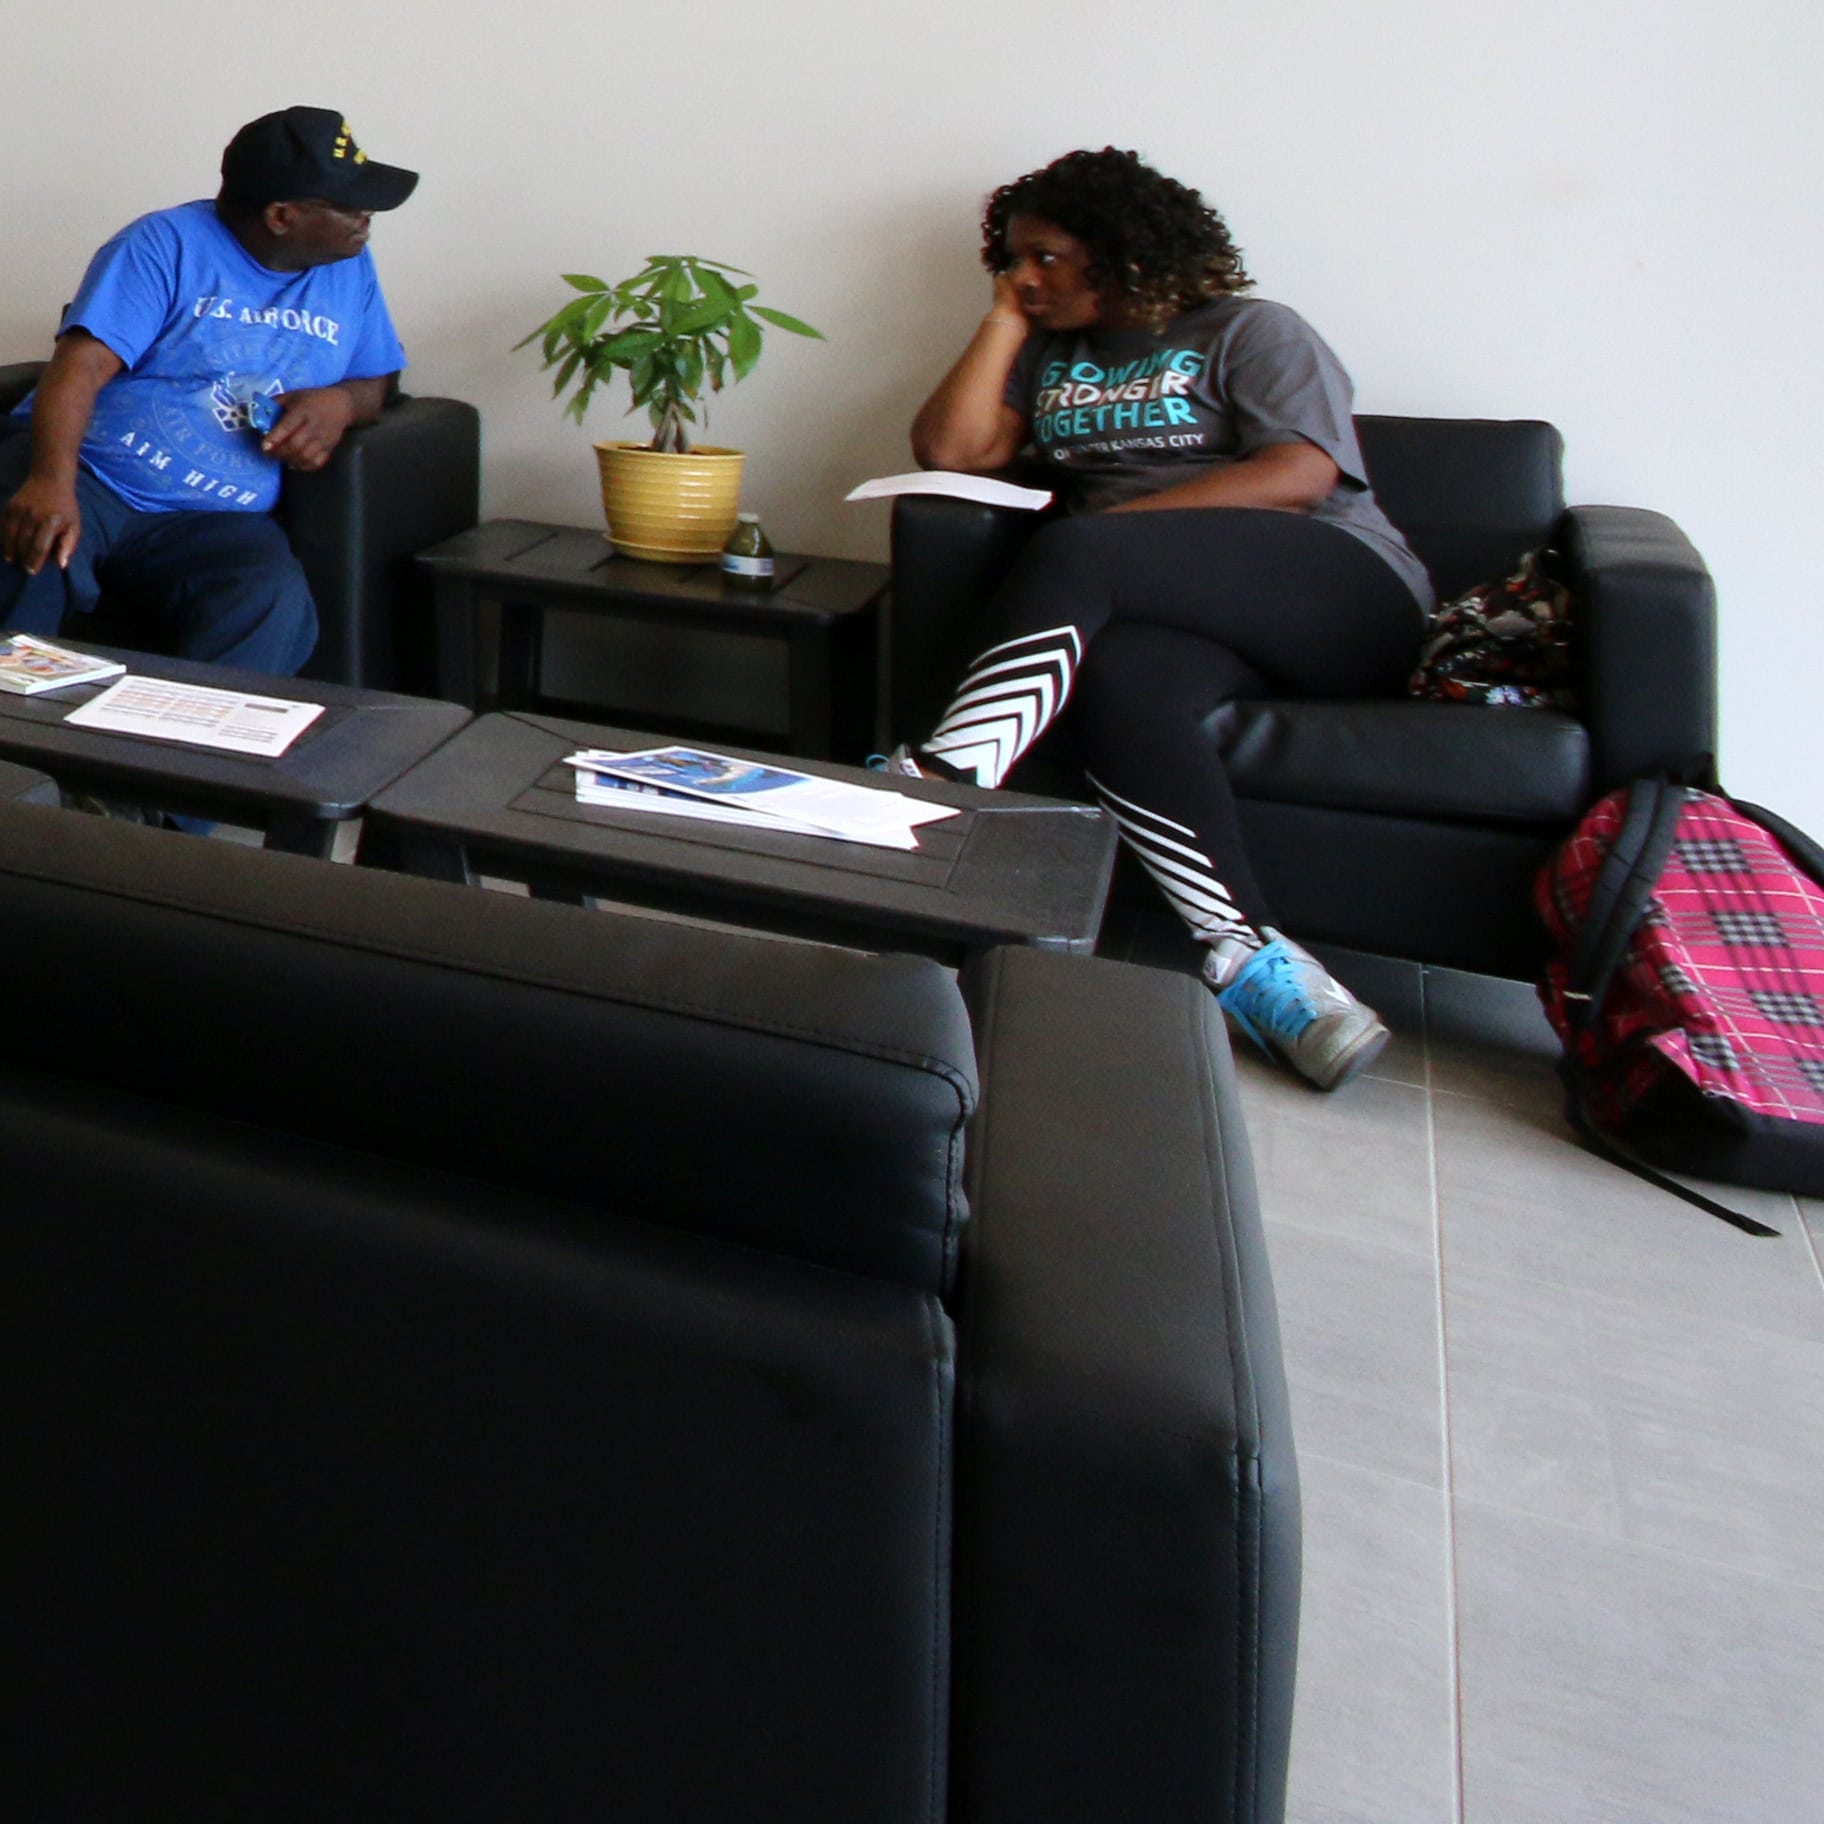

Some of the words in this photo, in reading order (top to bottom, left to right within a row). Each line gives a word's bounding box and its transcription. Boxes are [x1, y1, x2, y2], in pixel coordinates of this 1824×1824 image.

[193, 296, 232, 319] U.S.
[120, 431, 173, 471] AIM
[1110, 436, 1165, 451] KANSAS
[1168, 433, 1204, 448] CITY
[182, 469, 258, 505] HIGH
